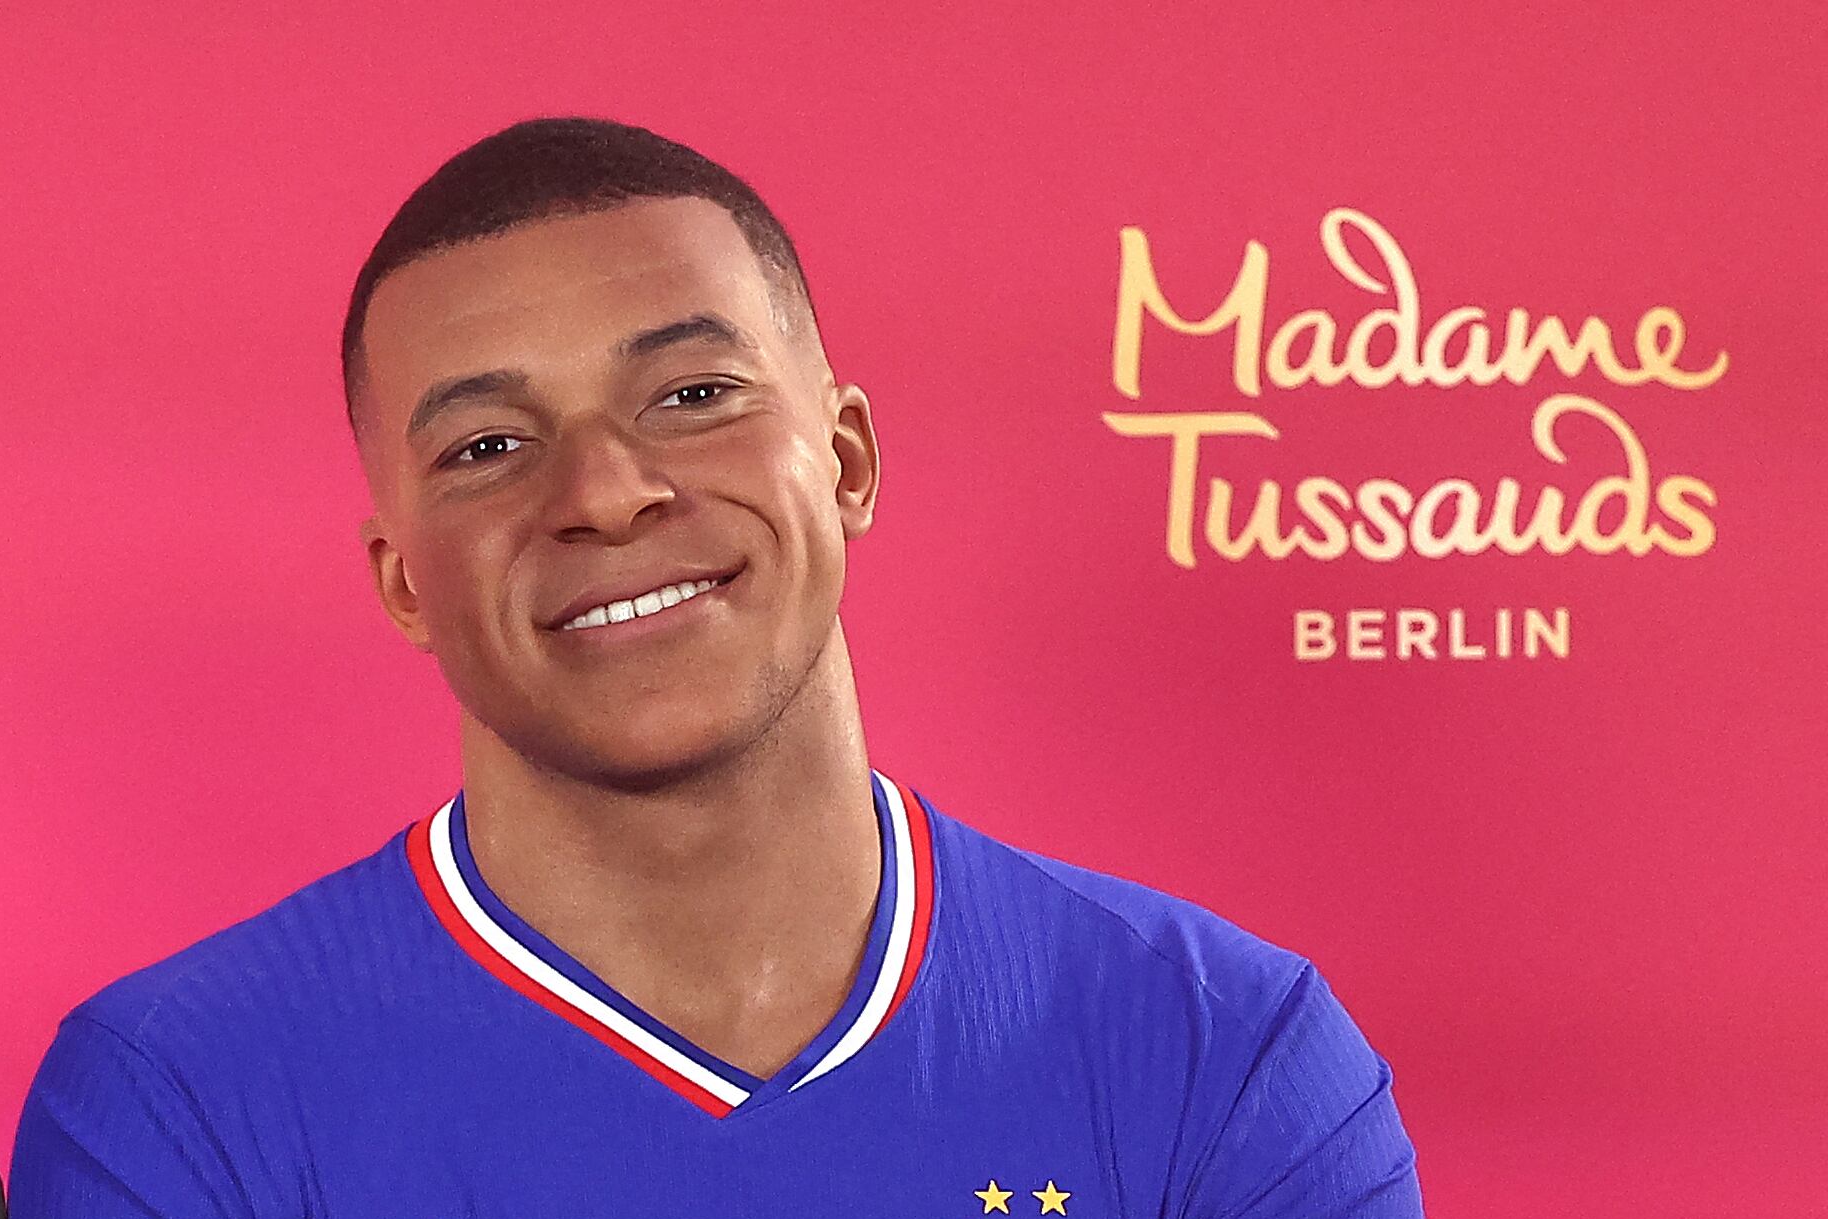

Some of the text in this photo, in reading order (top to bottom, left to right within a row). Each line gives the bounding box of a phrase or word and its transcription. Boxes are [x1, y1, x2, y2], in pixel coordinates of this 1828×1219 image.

[1113, 207, 1729, 400] Madame
[1102, 393, 1717, 568] Tussauds
[1294, 608, 1571, 660] BERLIN
